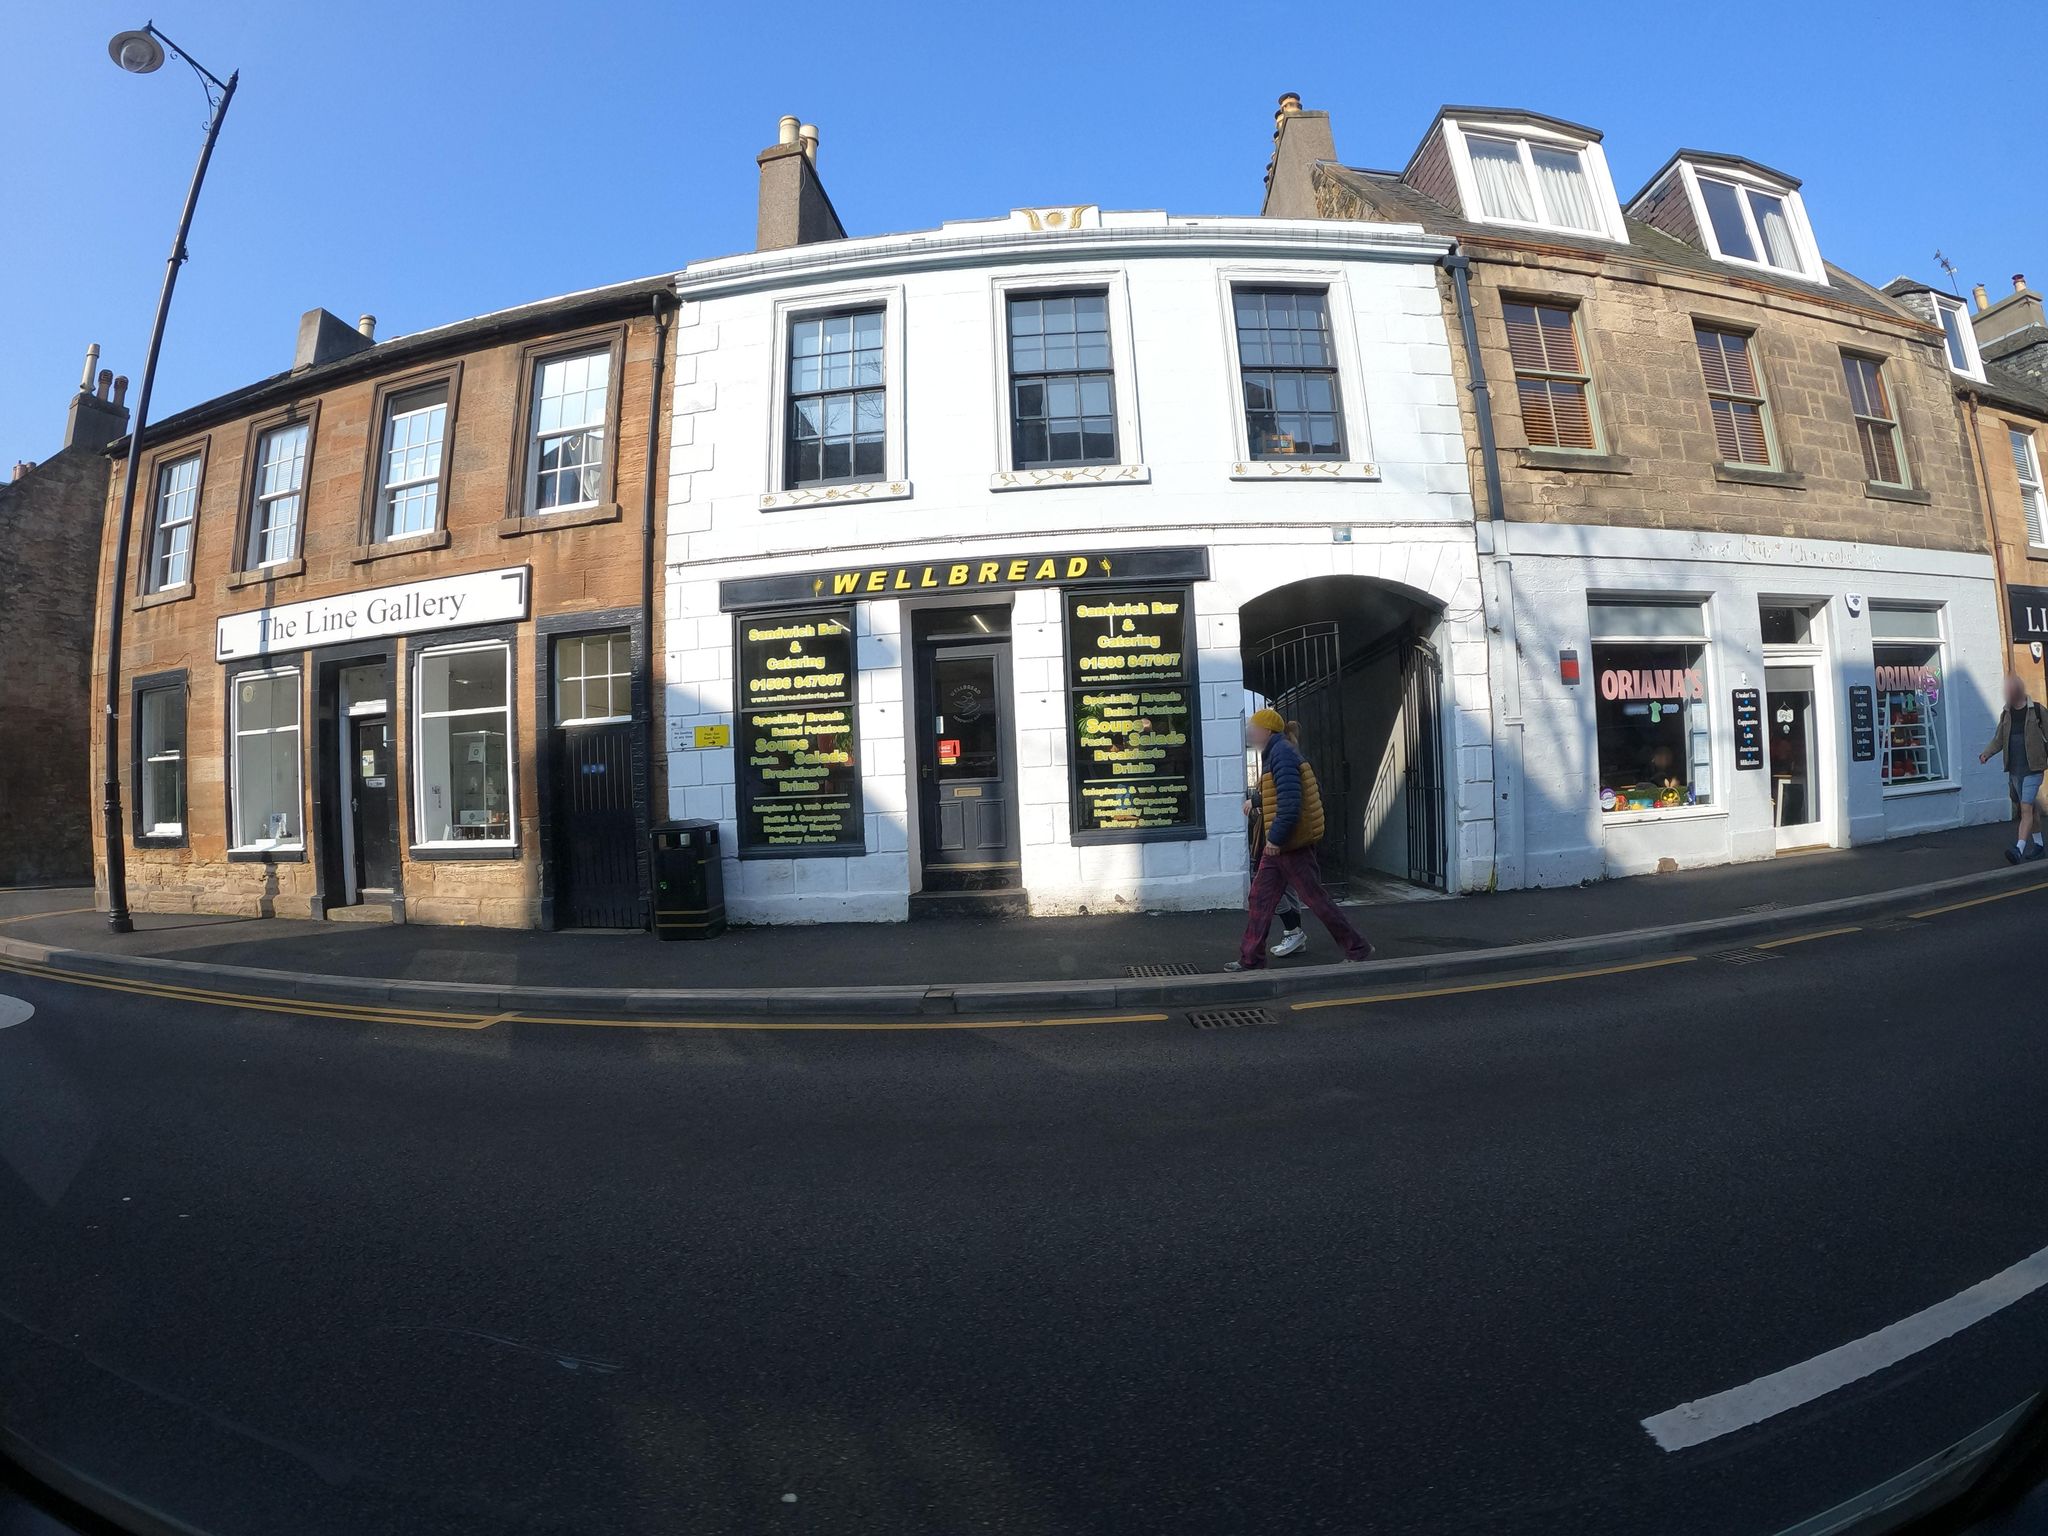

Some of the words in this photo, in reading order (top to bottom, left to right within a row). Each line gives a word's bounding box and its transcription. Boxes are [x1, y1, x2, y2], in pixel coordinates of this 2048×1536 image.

[834, 557, 1088, 594] WELLBREAD
[257, 616, 297, 642] The
[304, 607, 357, 635] Line
[367, 591, 467, 624] Gallery
[1076, 603, 1149, 618] Sandwich
[1151, 601, 1179, 615] Bar
[1122, 618, 1136, 632] &
[2026, 606, 2048, 632] LI
[748, 624, 816, 641] Sandwich
[818, 623, 843, 636] Bar
[789, 640, 802, 653] &
[1097, 634, 1161, 649] Catering
[766, 655, 826, 670] Catering
[1080, 655, 1125, 670] 01506
[1127, 653, 1181, 667] 847007
[750, 677, 791, 692] 01506
[794, 673, 845, 689] 847007
[1601, 667, 1704, 701] ORIANA'S
[1876, 665, 1938, 692] ORIAN
[1082, 693, 1140, 706] Speciality
[1141, 691, 1182, 702] Breads
[1104, 706, 1138, 717] Baked
[1139, 705, 1187, 716] Potatoes
[752, 714, 805, 727] Speciality
[806, 711, 845, 722] Breads
[1087, 718, 1145, 735] Soups
[771, 727, 803, 737] Baked
[804, 724, 850, 735] Potatoes
[755, 738, 809, 754] Soups
[1080, 736, 1113, 747] Pasta
[1129, 731, 1187, 746] Salads
[750, 755, 779, 766] Pasta
[794, 749, 849, 765] Salads
[1094, 748, 1167, 762] Breakfasts
[762, 766, 830, 779] Breakfasts
[1112, 762, 1156, 775] Drinks
[779, 780, 820, 792] Drinks
[1128, 785, 1137, 794] &
[1138, 785, 1157, 794] web
[1158, 784, 1188, 793] orders
[794, 803, 803, 811] &
[1123, 798, 1132, 806] &
[790, 815, 798, 823] &
